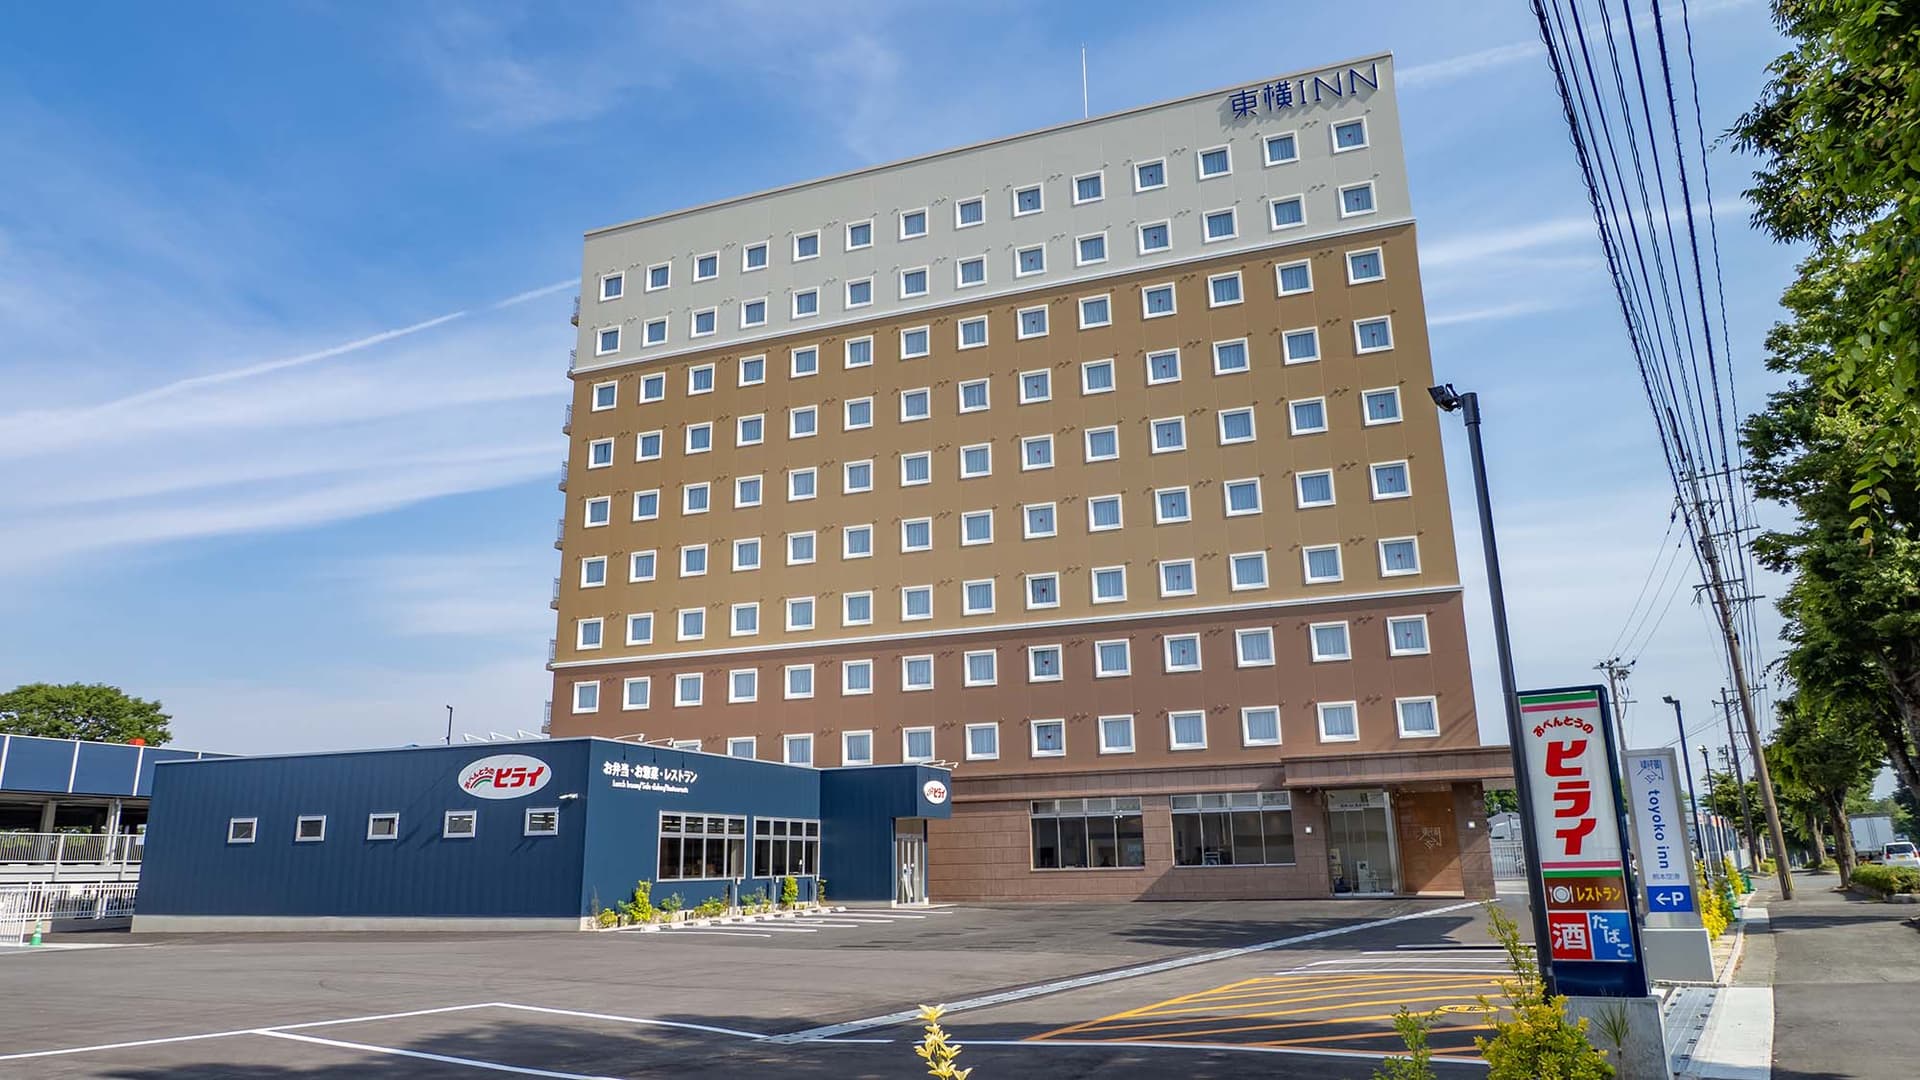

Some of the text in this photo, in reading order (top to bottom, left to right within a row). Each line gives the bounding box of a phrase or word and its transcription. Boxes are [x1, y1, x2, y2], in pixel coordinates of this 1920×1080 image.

[1229, 62, 1379, 119] 東横INN
[1532, 716, 1594, 738] おべんとうの
[493, 766, 545, 789] ヒライ
[1545, 739, 1597, 856] ヒライ
[1647, 789, 1667, 841] toyoko
[1656, 846, 1670, 869] inn
[1576, 886, 1622, 902] レストラン
[1671, 891, 1685, 906] P
[1552, 922, 1587, 950] 酒
[1592, 914, 1633, 958] たばこ
